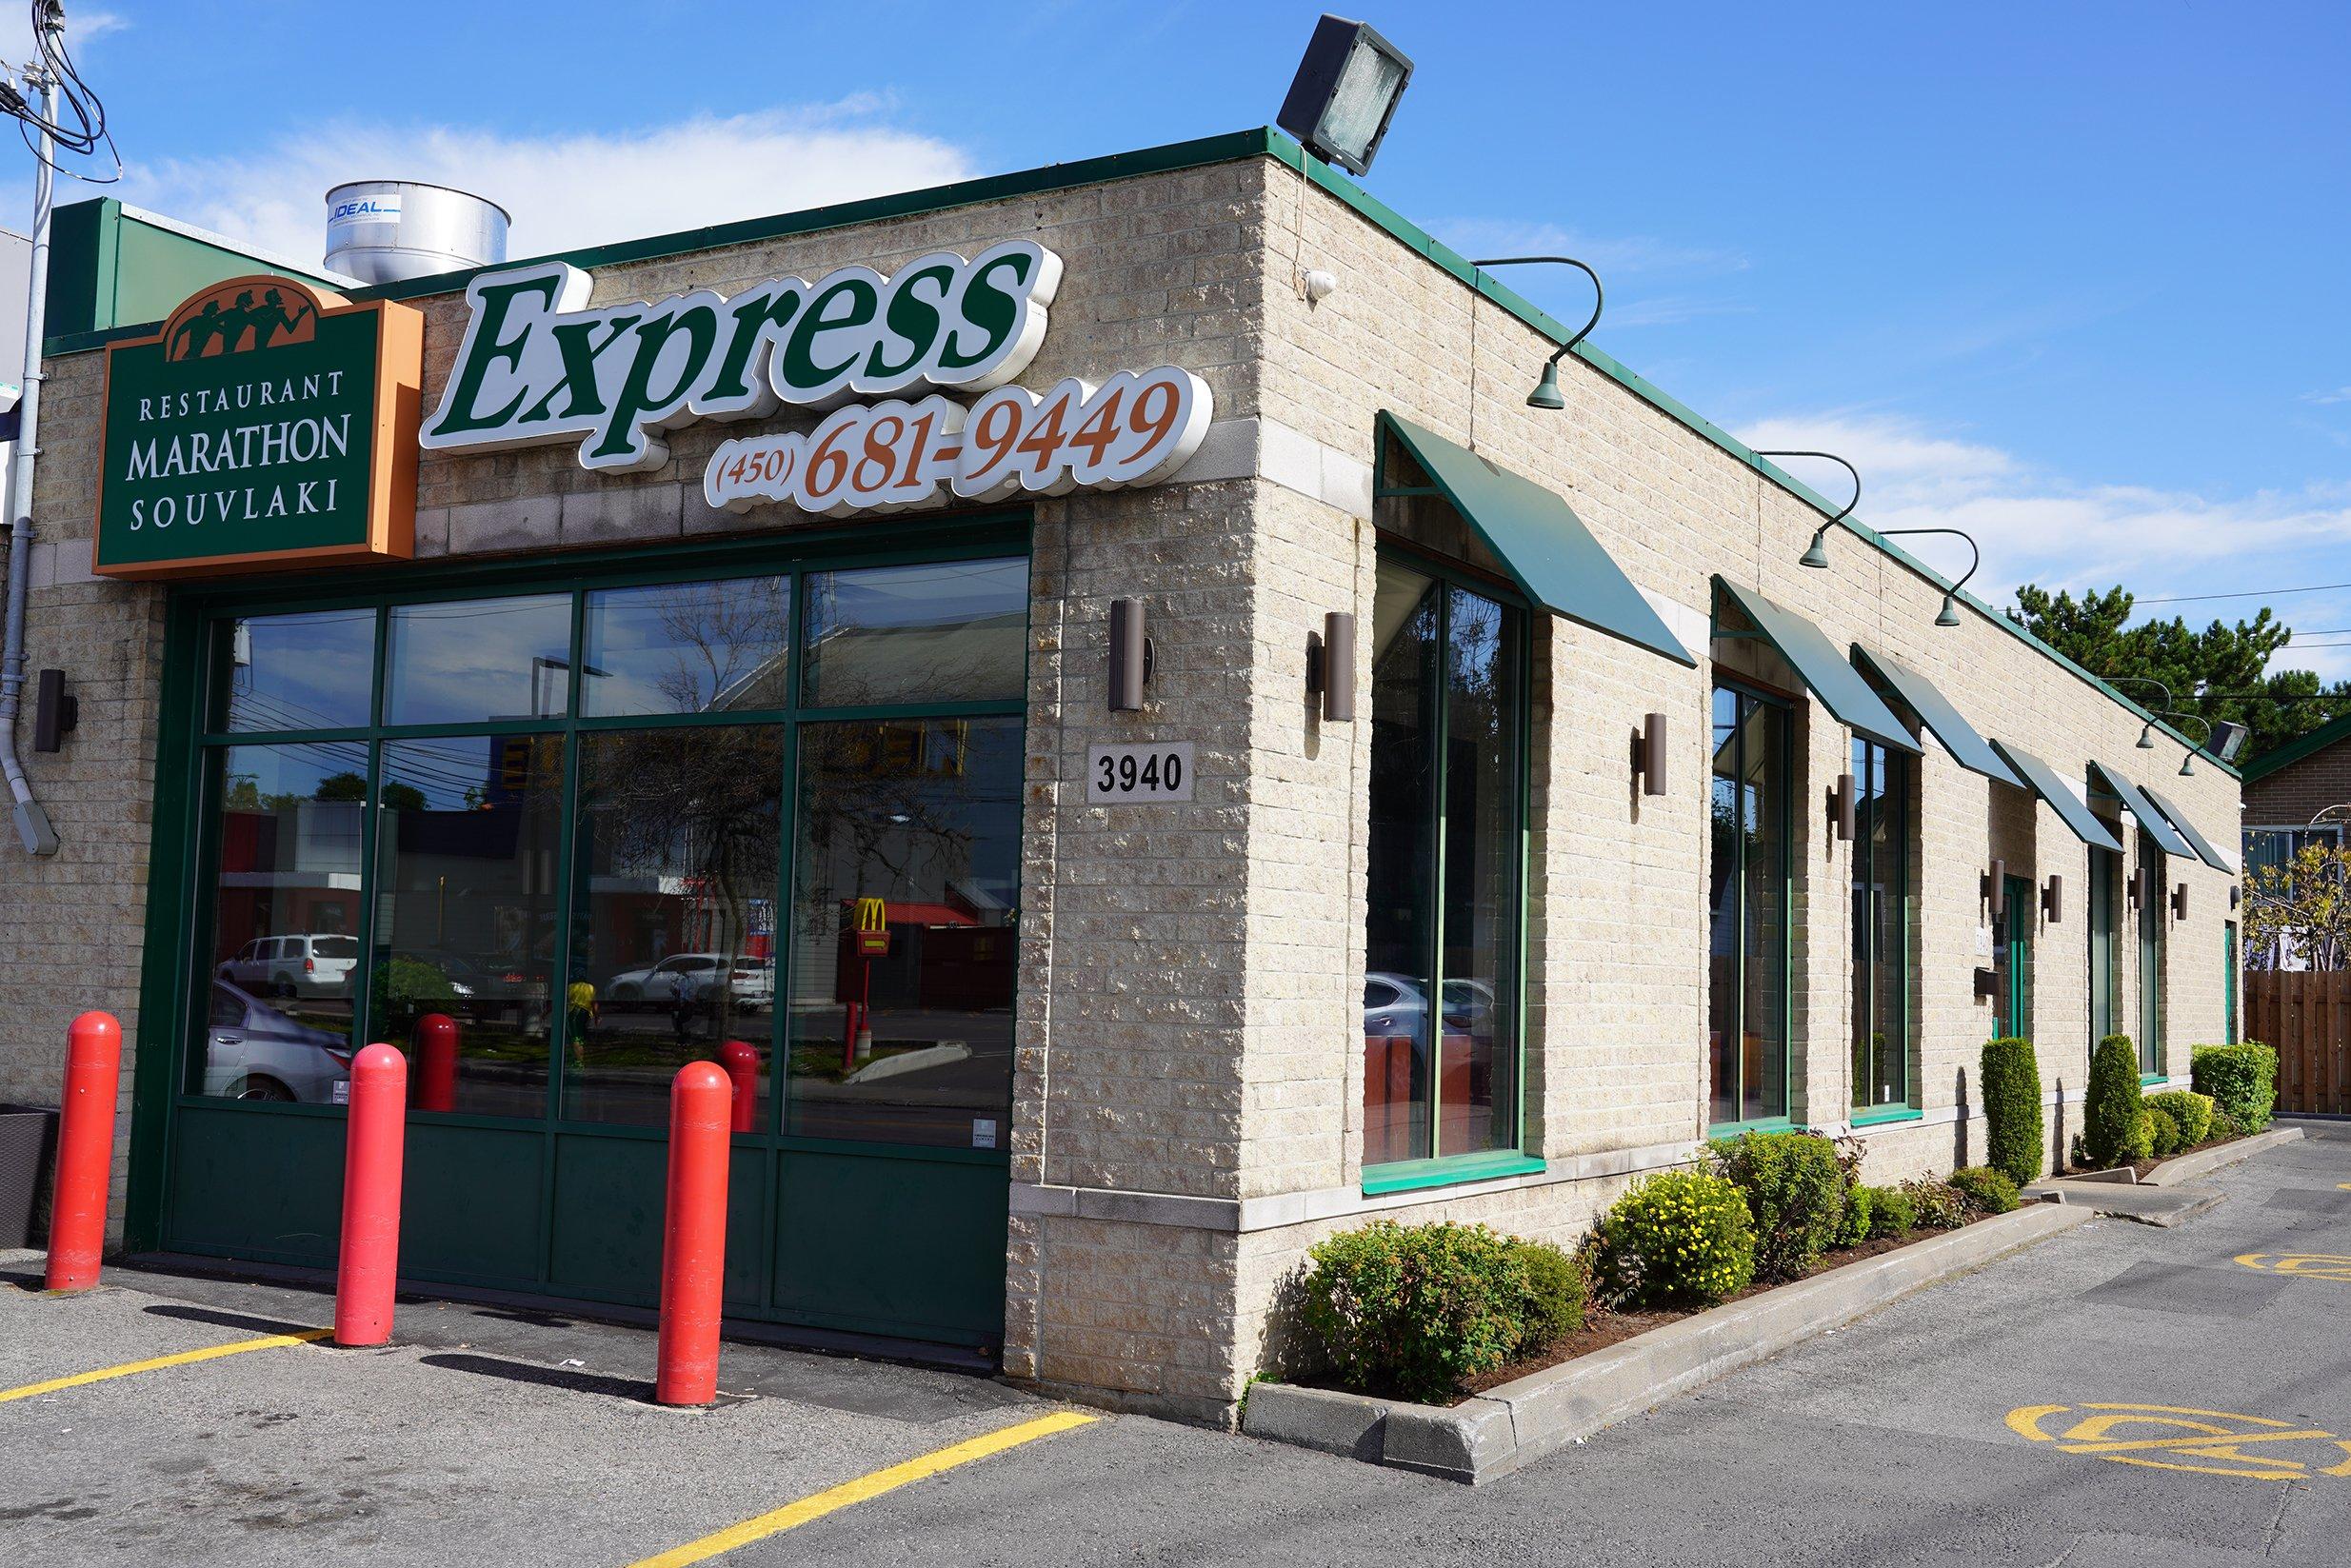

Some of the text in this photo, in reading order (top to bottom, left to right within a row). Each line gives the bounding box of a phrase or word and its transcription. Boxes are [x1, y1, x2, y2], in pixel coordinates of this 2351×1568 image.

[333, 201, 382, 220] IDEAL
[431, 251, 1032, 457] Express
[138, 370, 344, 422] RESTAURANT
[125, 413, 351, 481] MARATHON
[714, 380, 1180, 496] (450) 681-9449
[130, 479, 338, 531] SOUVLAKI
[1097, 753, 1183, 793] 3940
